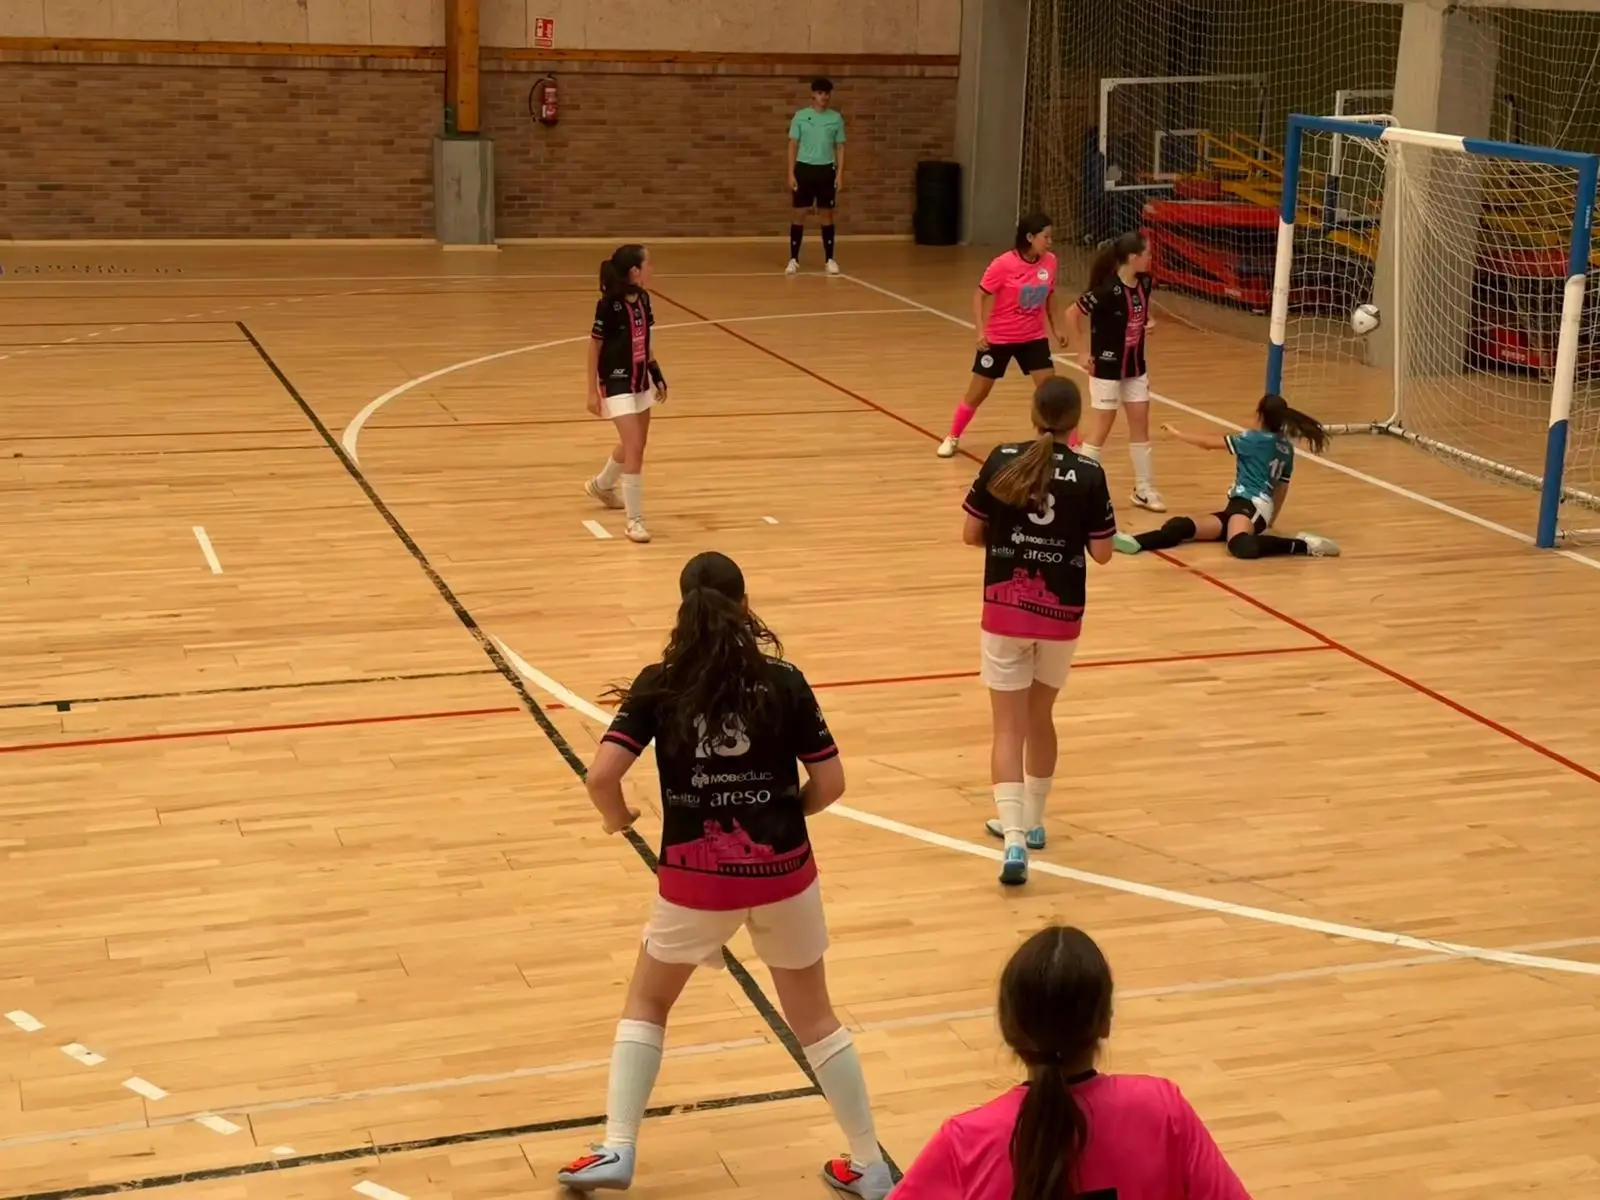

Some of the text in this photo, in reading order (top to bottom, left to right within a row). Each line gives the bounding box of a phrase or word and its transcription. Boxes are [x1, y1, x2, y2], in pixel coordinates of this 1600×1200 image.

[1053, 467, 1078, 483] LA
[1027, 493, 1056, 526] 3
[1023, 548, 1063, 564] areso
[710, 789, 771, 807] areso
